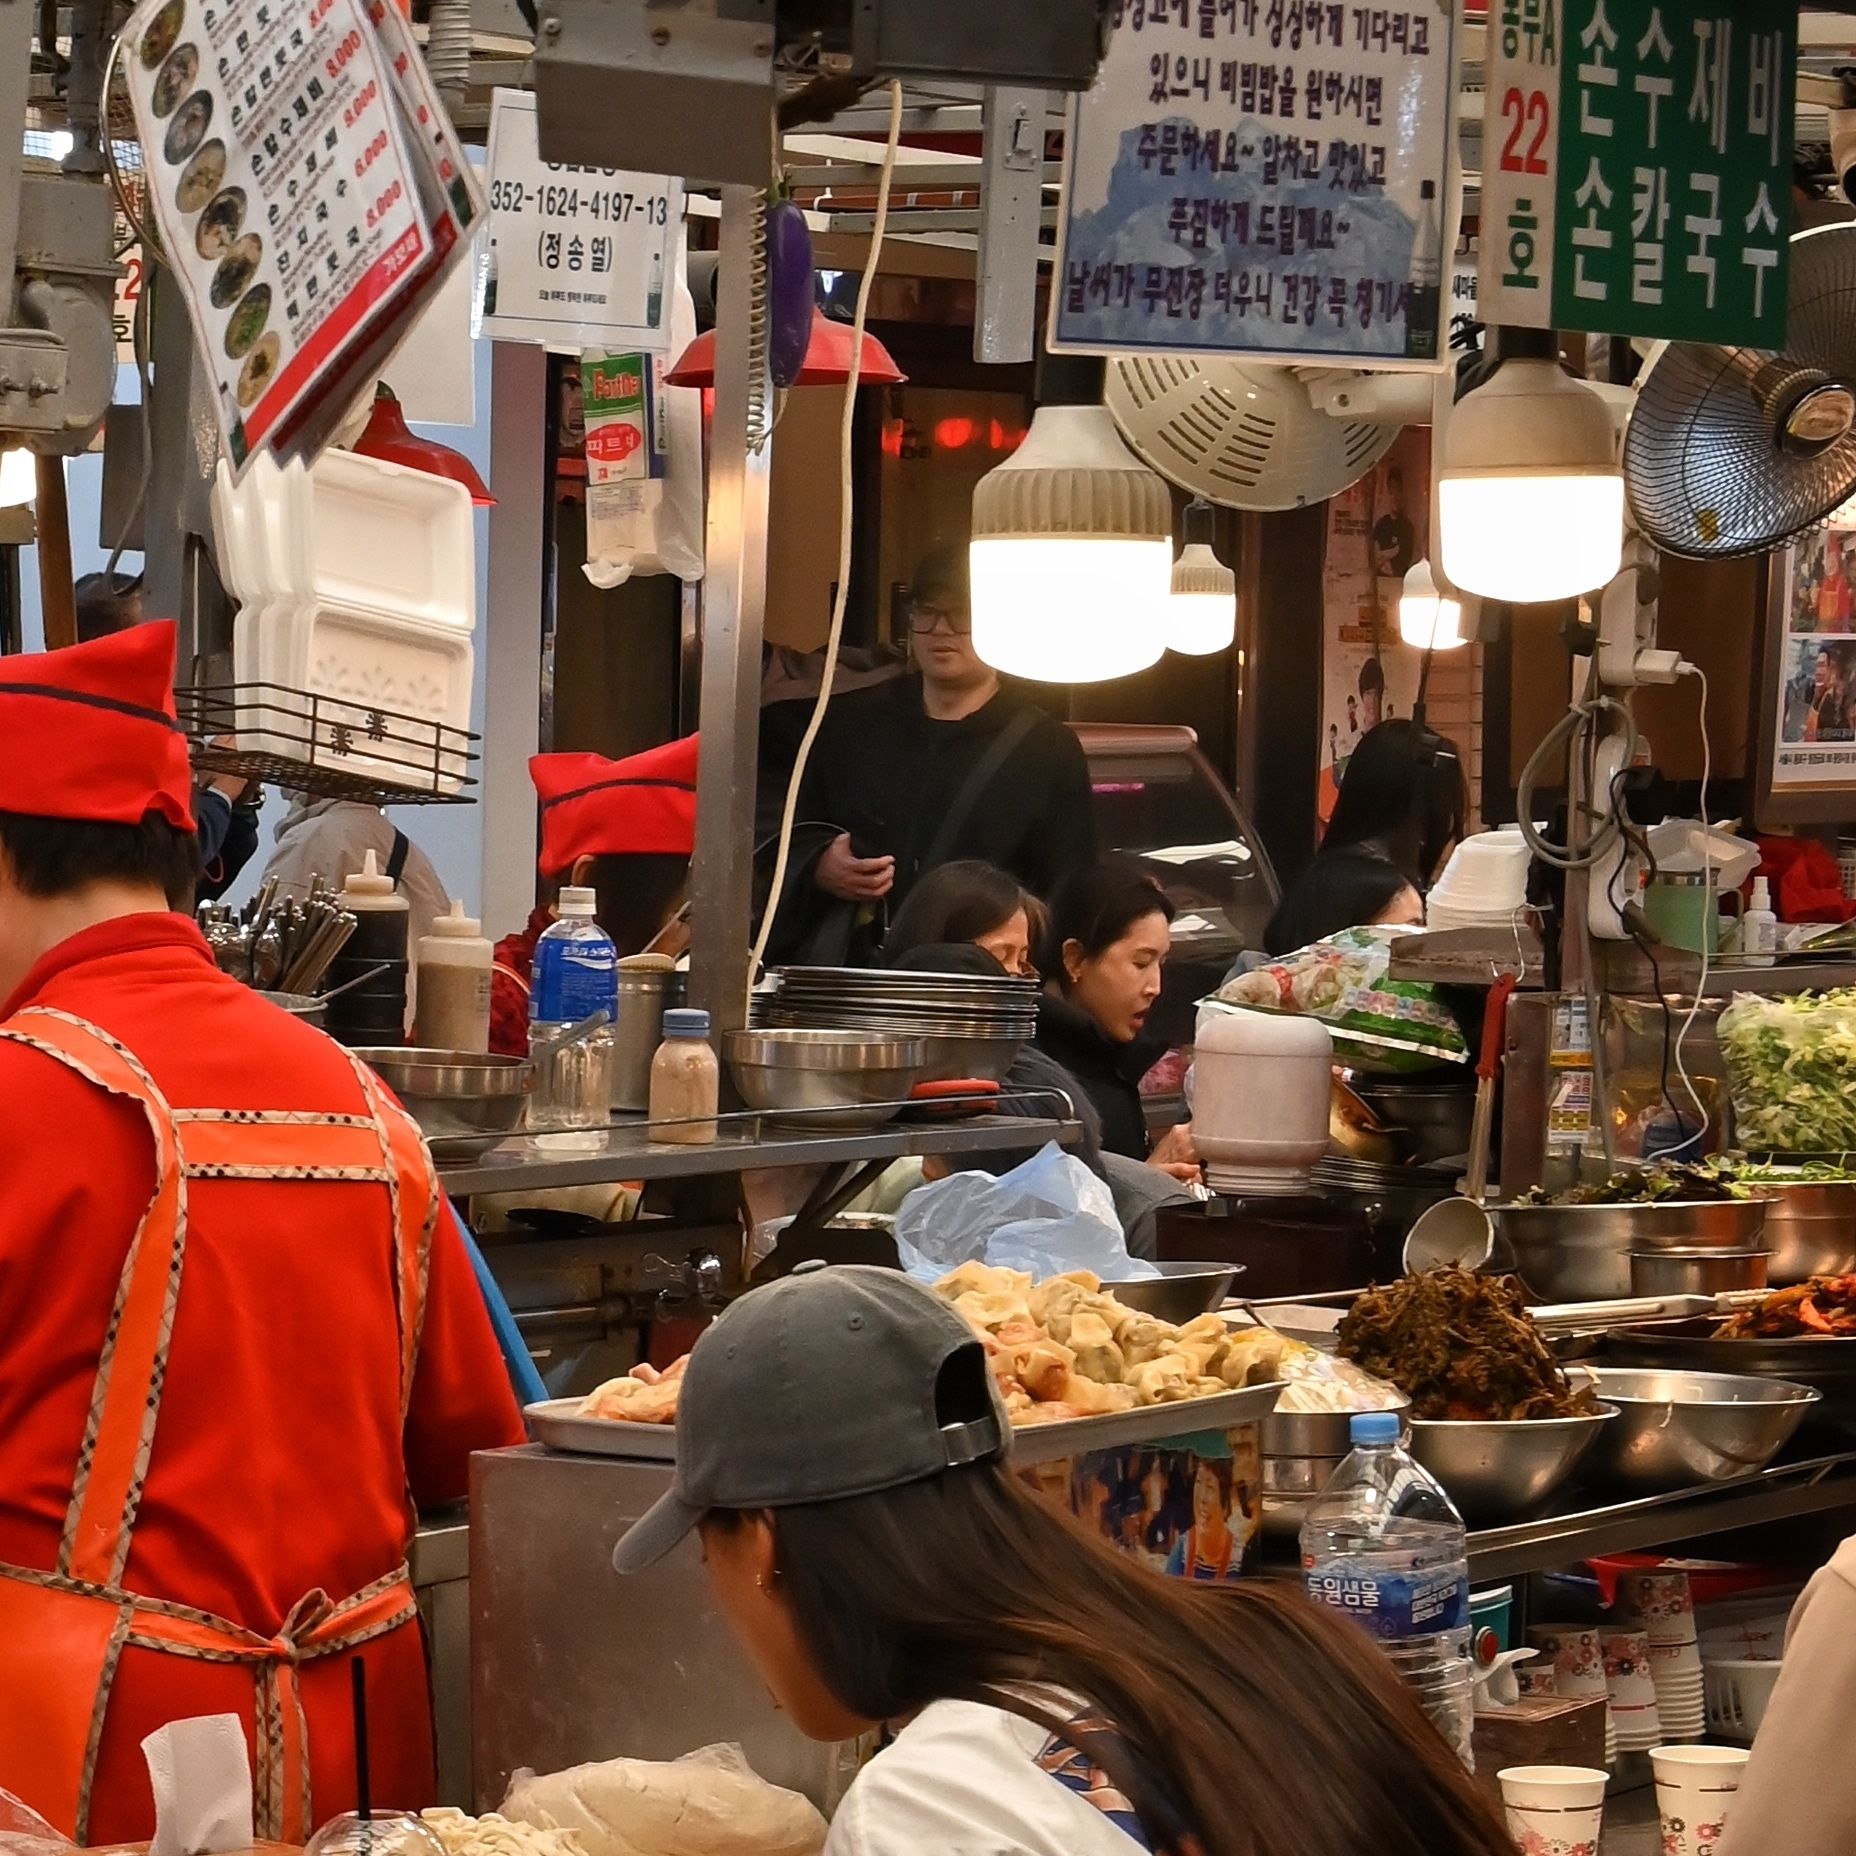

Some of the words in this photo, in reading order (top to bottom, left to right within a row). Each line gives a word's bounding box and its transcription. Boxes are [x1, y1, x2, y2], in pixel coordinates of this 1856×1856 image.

[1351, 7, 1430, 55] 기다리고
[1148, 52, 1211, 106] 있으니
[1219, 60, 1298, 119] 비빔밥을
[1499, 86, 1550, 176] 22
[490, 179, 668, 227] 352-1624-4197-13
[1501, 198, 1540, 289] 호
[1571, 155, 1780, 319] 손칼국수
[123, 258, 143, 301] 2
